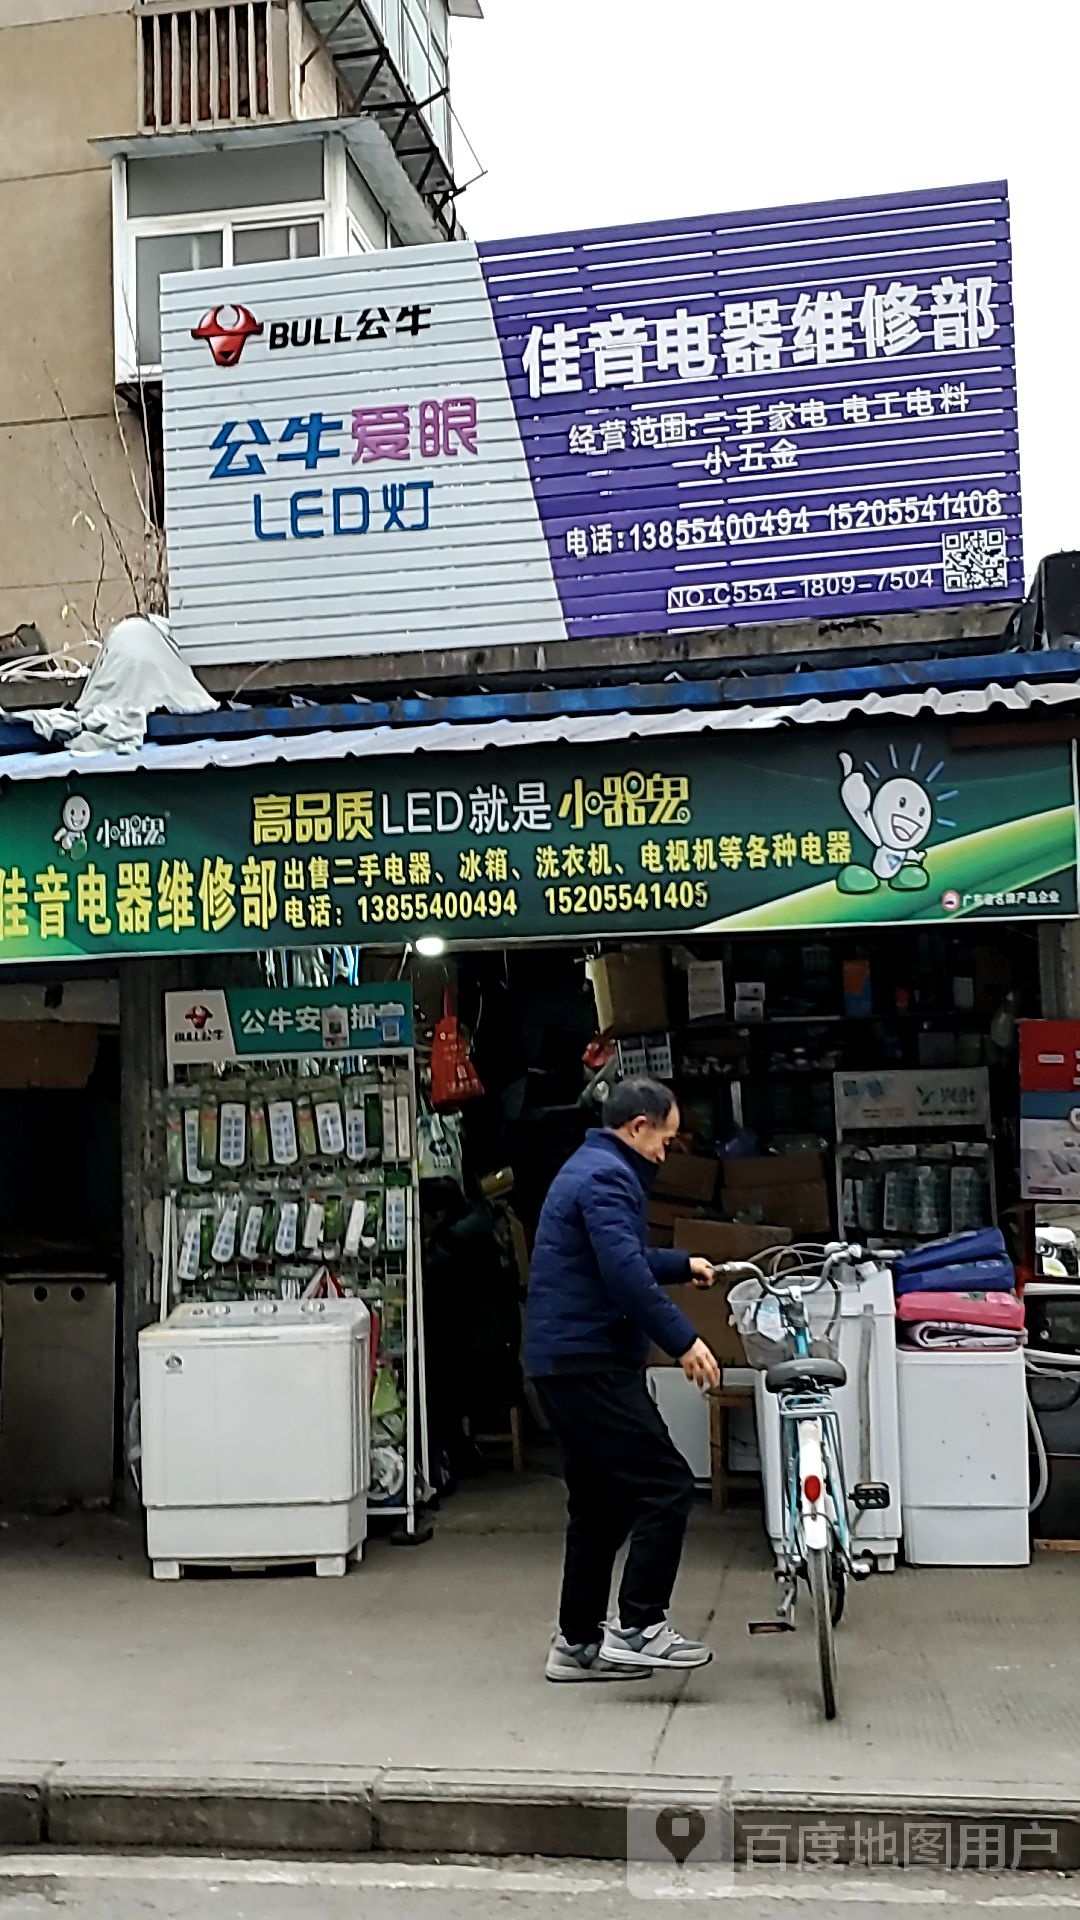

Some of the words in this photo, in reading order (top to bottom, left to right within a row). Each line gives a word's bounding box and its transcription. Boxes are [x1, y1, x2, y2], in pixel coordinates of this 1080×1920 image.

[268, 304, 432, 350] BULL公牛
[521, 276, 998, 399] 佳音电器维修部
[842, 382, 969, 423] 电工电料
[208, 395, 479, 479] 公牛爱眼
[704, 437, 798, 476] 小五金
[252, 481, 434, 540] LED灯
[827, 489, 1001, 530] 15205541408
[0, 855, 278, 940] 佳音电器维修部
[545, 880, 708, 915] 15205541405
[240, 1002, 406, 1036] 公牛安插
